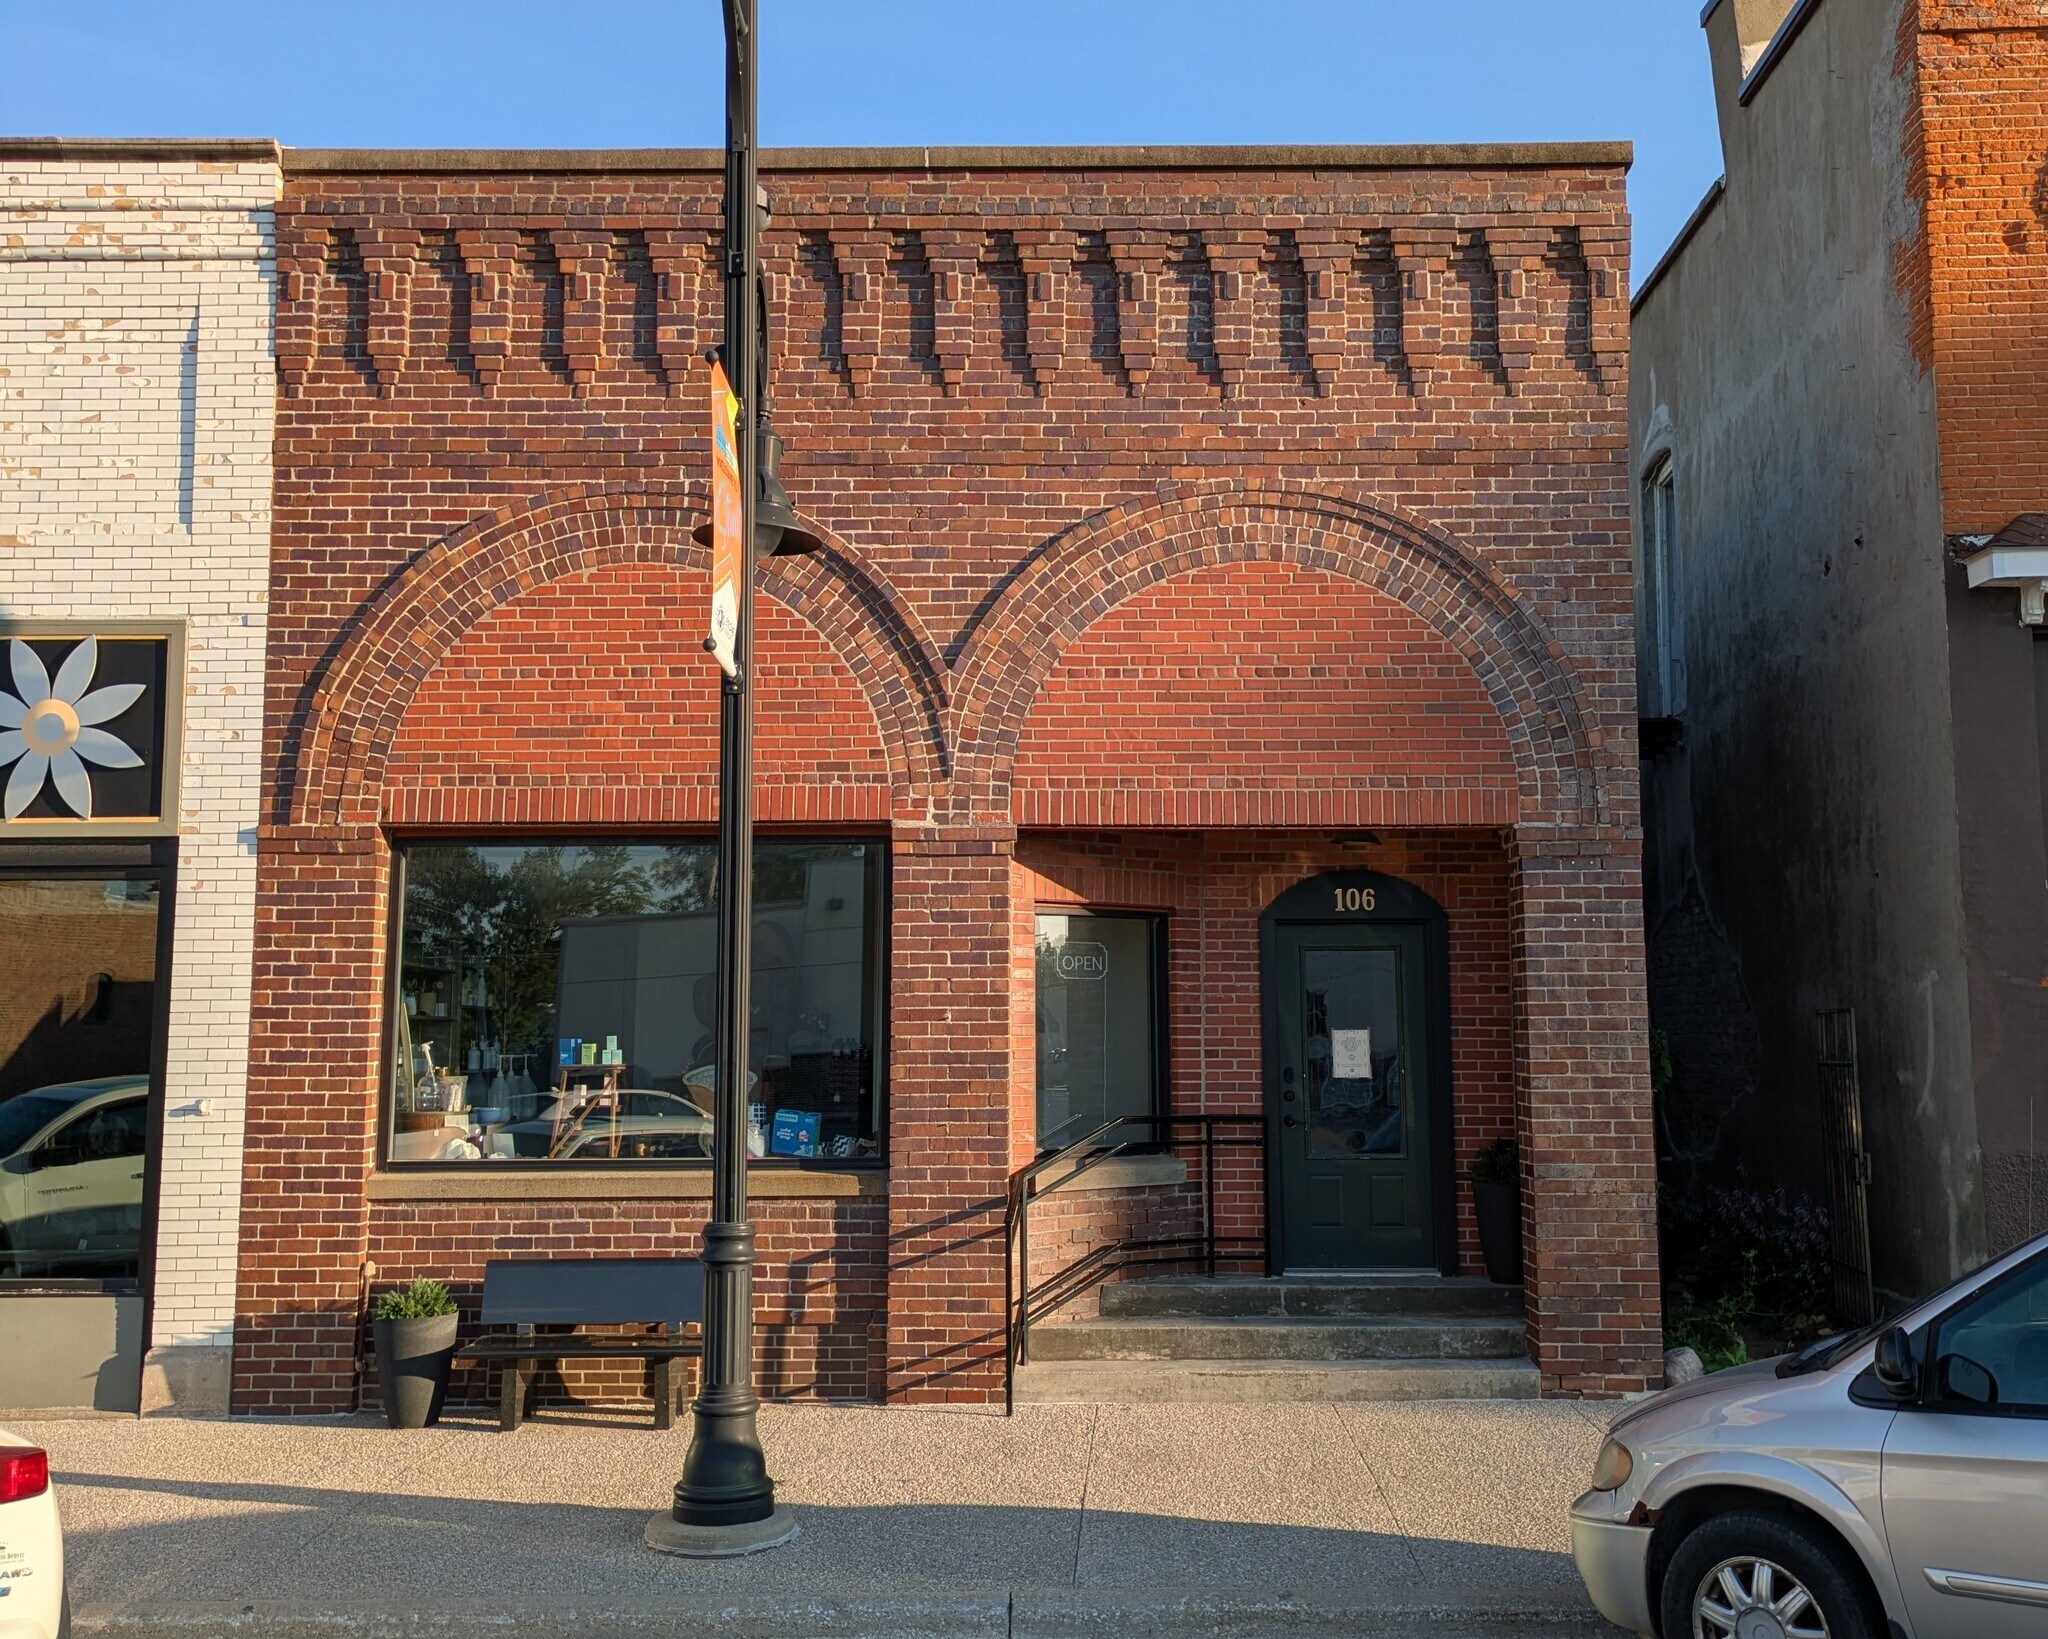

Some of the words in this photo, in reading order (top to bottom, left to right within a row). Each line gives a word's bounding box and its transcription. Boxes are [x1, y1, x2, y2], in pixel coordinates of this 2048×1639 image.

[1334, 888, 1375, 911] 106
[1062, 955, 1103, 970] OPEN
[0, 1567, 33, 1579] AWD
